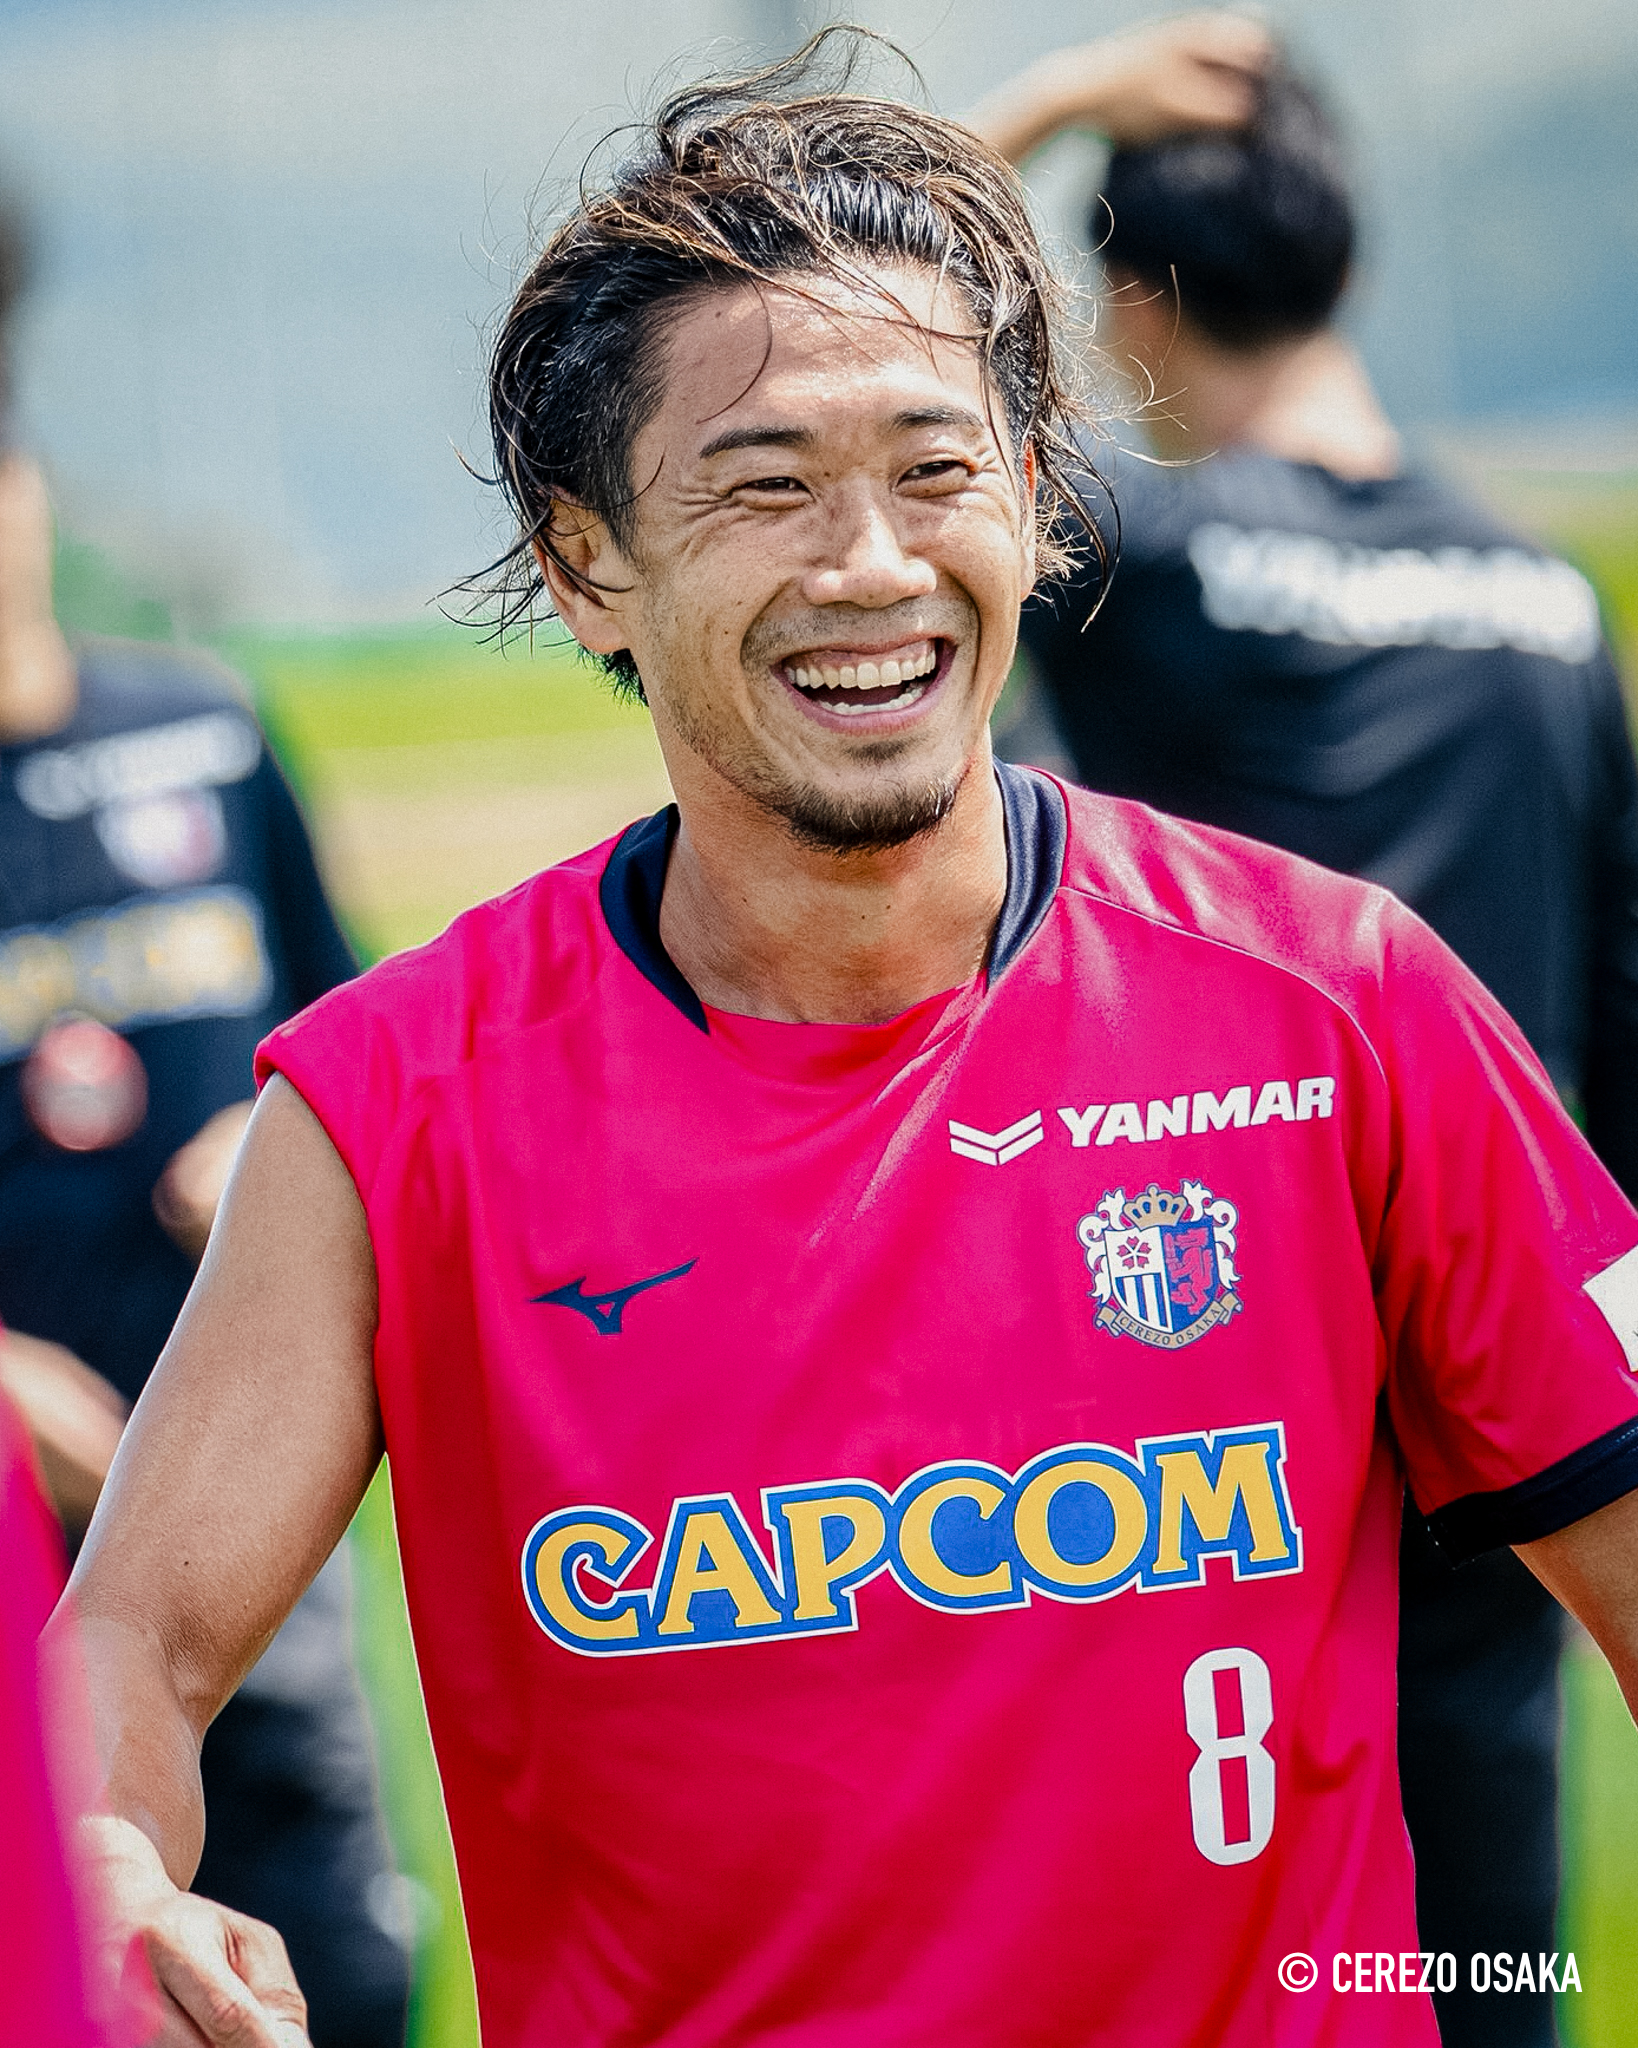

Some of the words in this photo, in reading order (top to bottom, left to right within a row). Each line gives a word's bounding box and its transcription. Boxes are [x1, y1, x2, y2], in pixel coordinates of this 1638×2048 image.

[1057, 1077, 1335, 1148] YANMAR
[1118, 1315, 1171, 1346] CEREZO
[1176, 1306, 1222, 1345] OSAKA
[522, 1421, 1304, 1657] CAPCOM
[1183, 1647, 1276, 1866] 8
